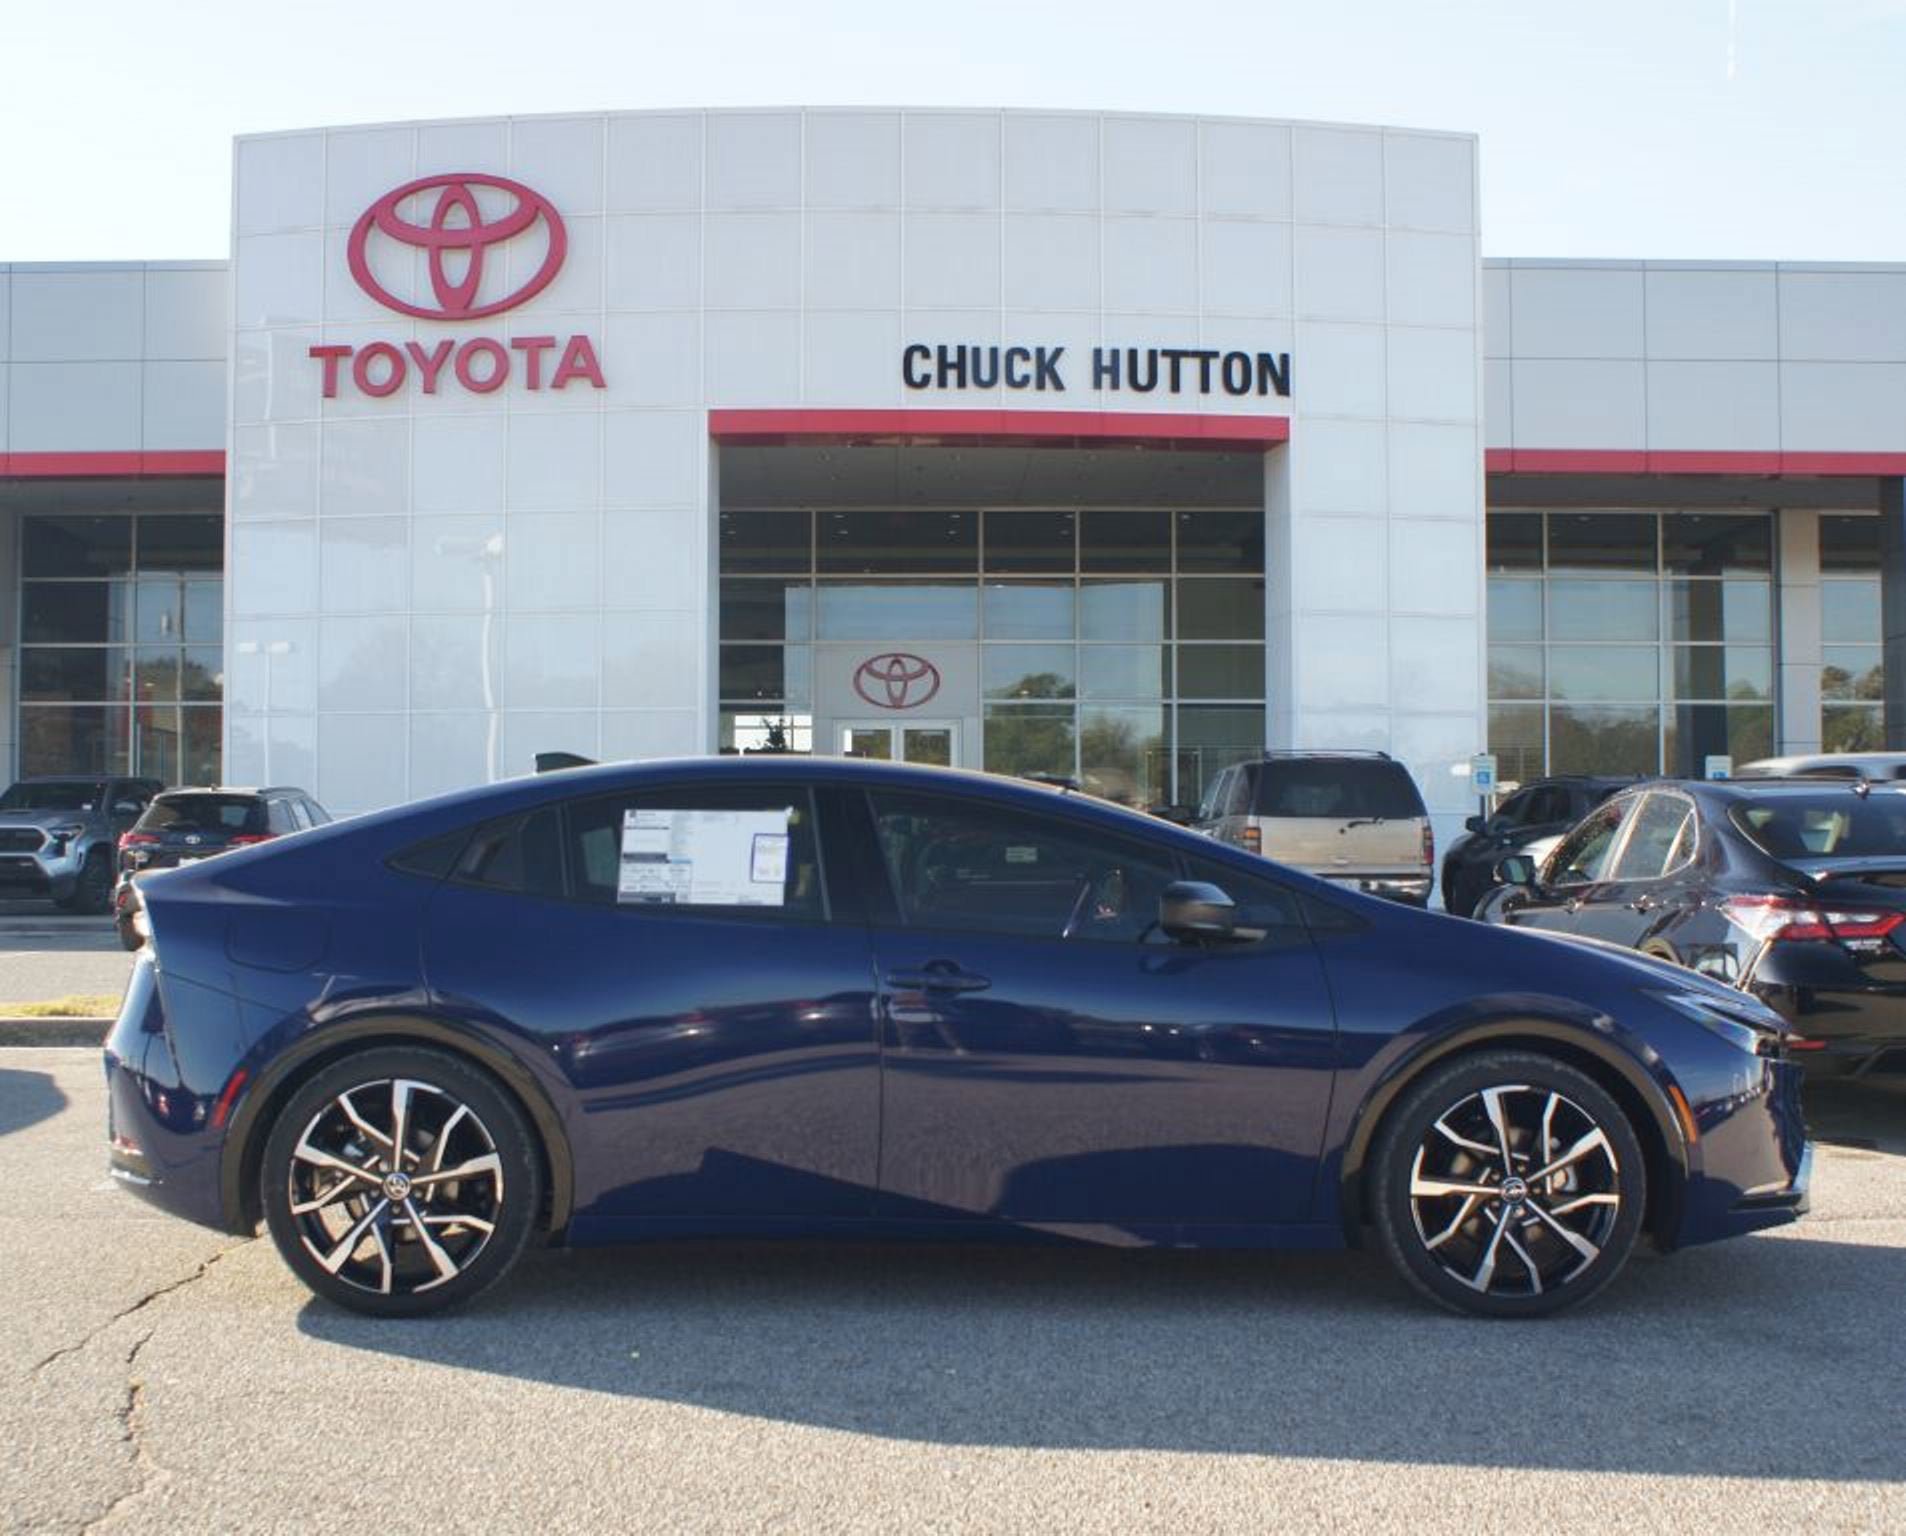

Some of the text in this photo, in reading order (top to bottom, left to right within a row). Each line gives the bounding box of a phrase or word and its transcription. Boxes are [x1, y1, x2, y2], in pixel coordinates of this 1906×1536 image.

[309, 335, 607, 398] TOYOTA
[902, 344, 1291, 397] CHUCK HUTTON
